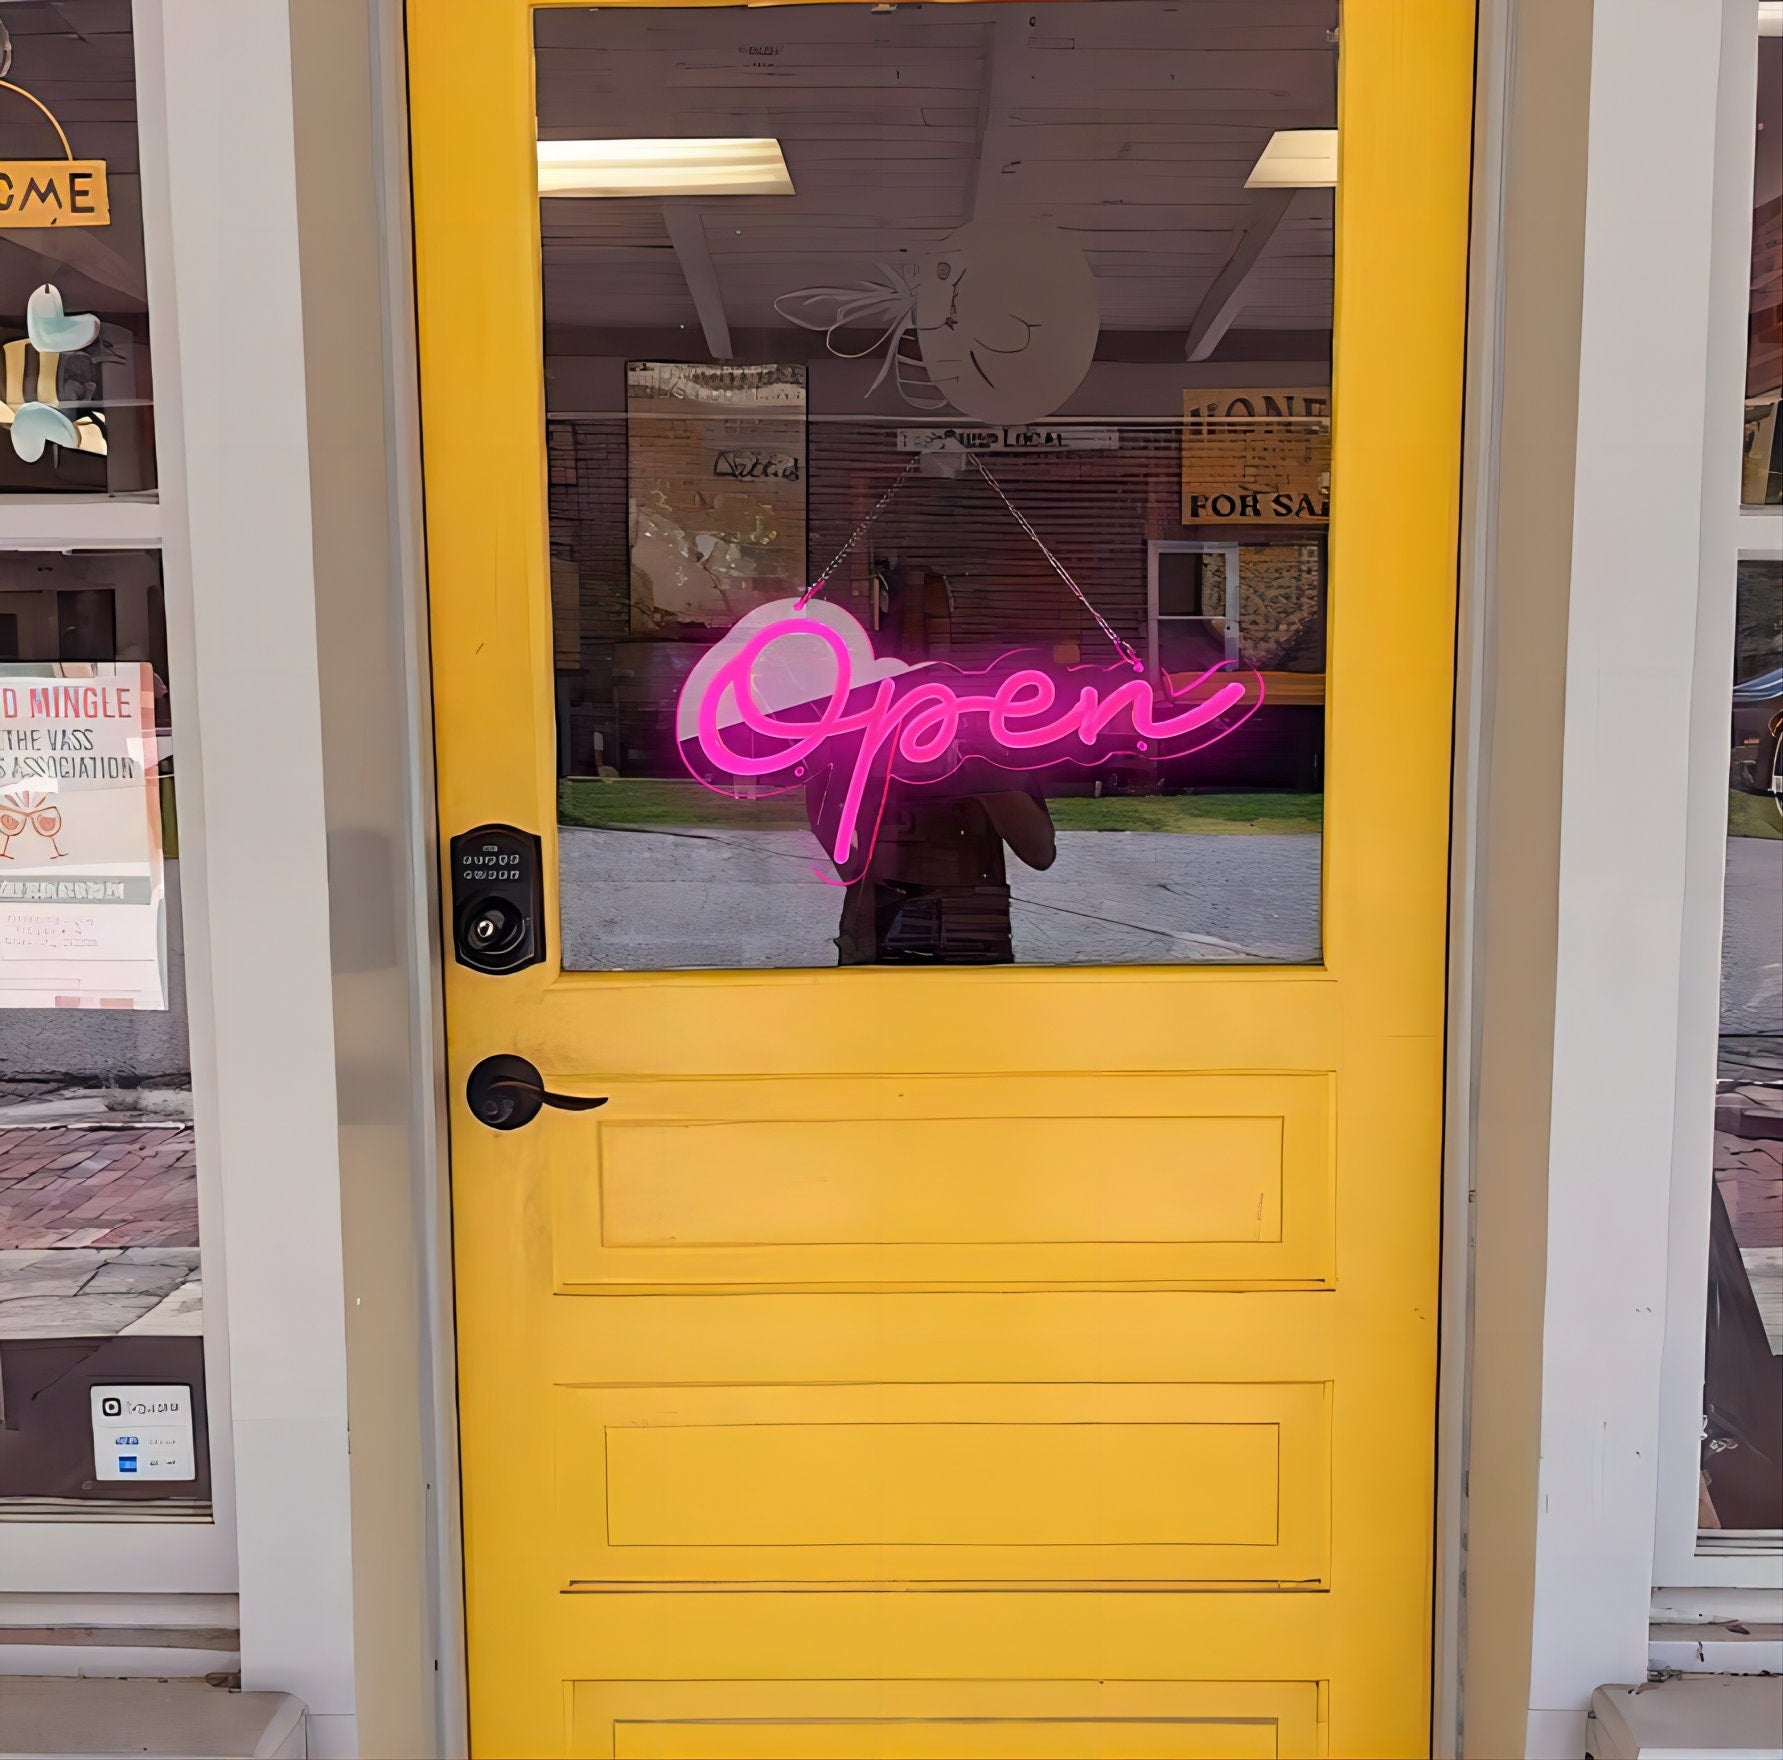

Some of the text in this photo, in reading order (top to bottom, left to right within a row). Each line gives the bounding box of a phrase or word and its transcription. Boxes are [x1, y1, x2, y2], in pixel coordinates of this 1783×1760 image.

[1190, 494, 1261, 518] FOR
[29, 686, 132, 718] MINGLE
[699, 618, 1245, 864] Open
